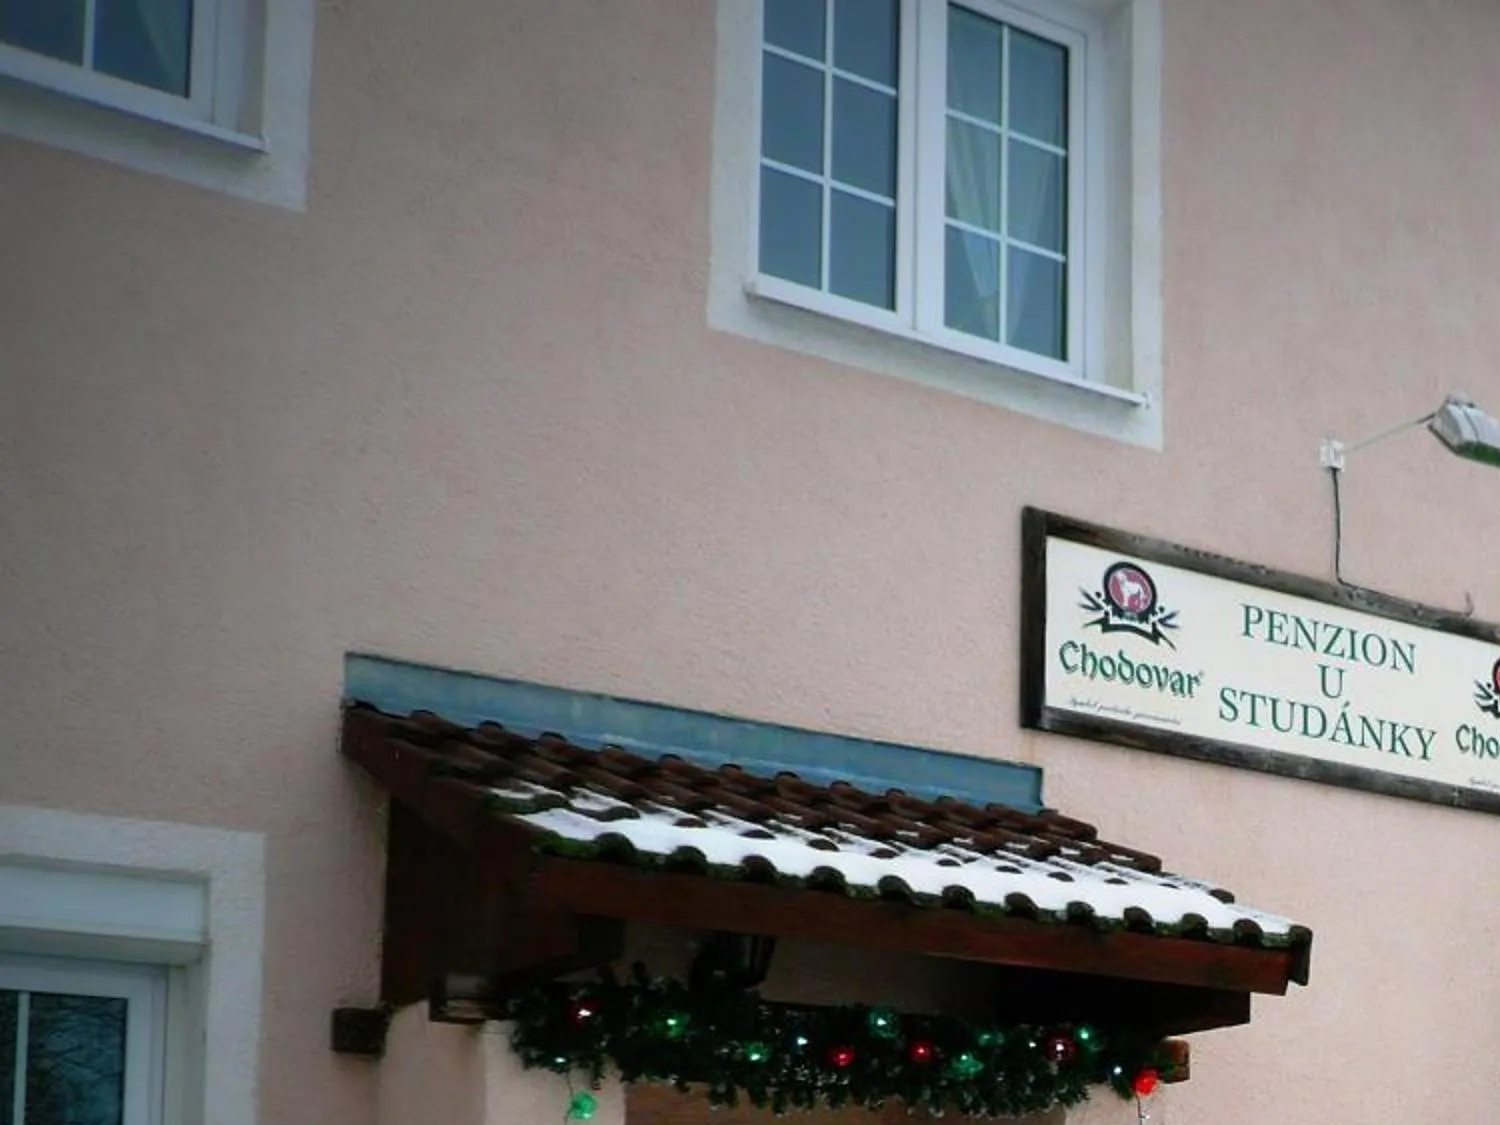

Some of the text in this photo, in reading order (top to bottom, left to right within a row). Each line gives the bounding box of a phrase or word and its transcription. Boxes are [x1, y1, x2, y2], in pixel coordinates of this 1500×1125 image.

[1059, 640, 1201, 698] Chodovar
[1241, 604, 1416, 674] PENZION
[1317, 664, 1346, 698] U
[1219, 687, 1437, 760] STUDÁNKY
